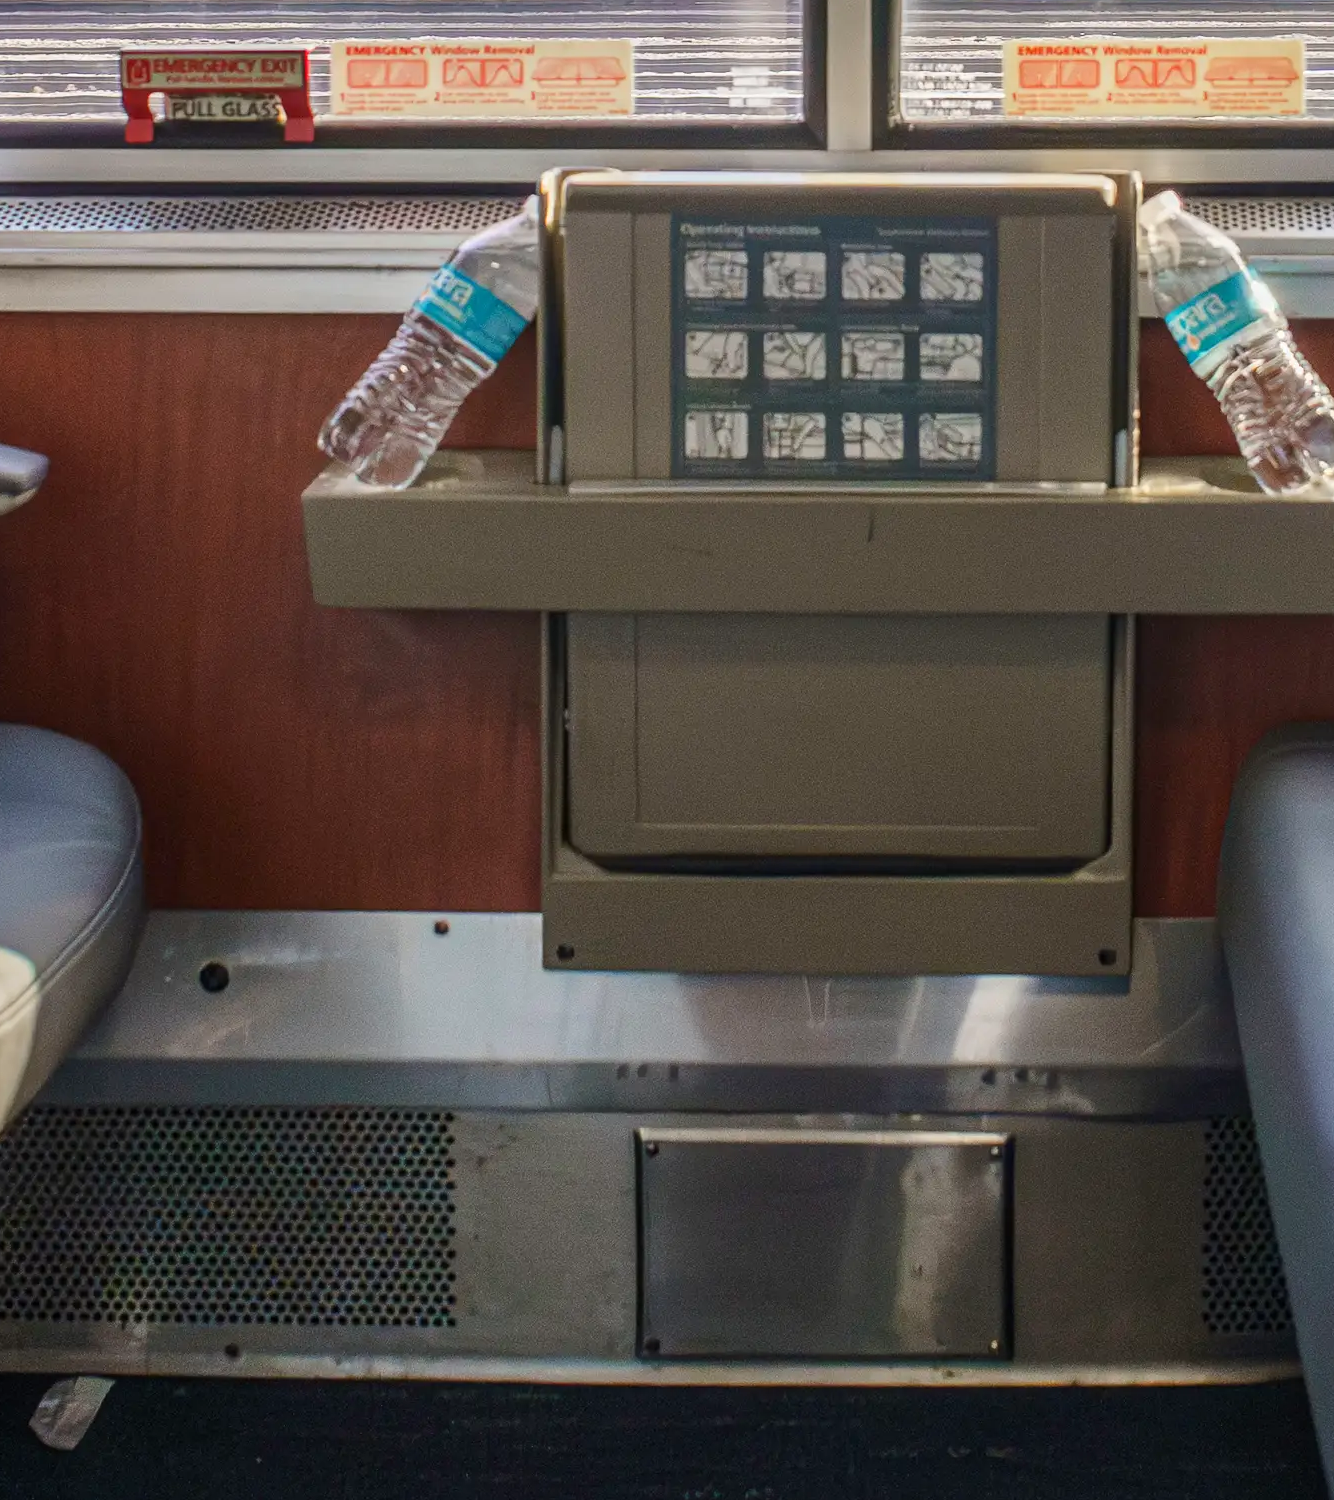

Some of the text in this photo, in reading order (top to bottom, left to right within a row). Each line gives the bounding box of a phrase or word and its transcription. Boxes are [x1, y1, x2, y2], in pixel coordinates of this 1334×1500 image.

[346, 44, 535, 56] EMERGENCY Window Removal
[1017, 44, 1208, 57] EMERGENCY Window Removal
[153, 58, 298, 74] EMERGENCY EXIT
[171, 102, 280, 117] PULL GLASS
